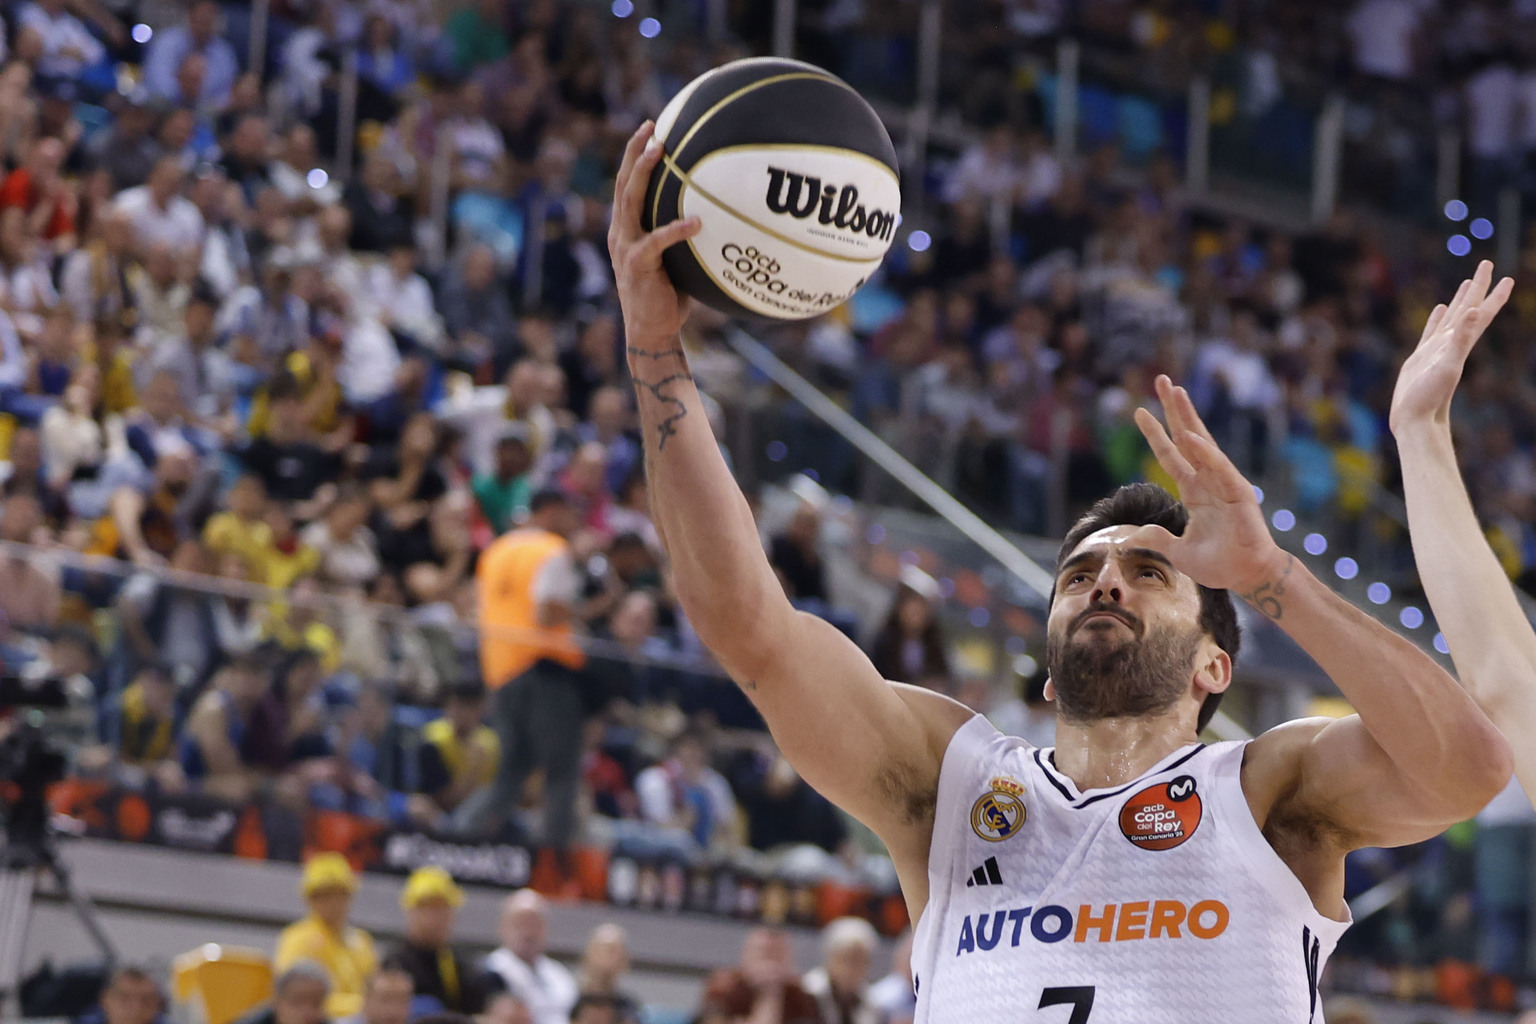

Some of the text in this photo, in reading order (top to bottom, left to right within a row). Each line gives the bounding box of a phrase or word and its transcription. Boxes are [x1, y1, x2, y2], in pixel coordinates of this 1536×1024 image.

[766, 165, 895, 242] Wilson
[722, 244, 788, 294] Copa
[745, 246, 781, 274] acb
[1134, 810, 1175, 822] Copa
[1143, 804, 1165, 813] acb
[1148, 832, 1175, 841] Canaria
[1155, 821, 1181, 832] Rey
[956, 899, 1230, 957] AUTOHERO
